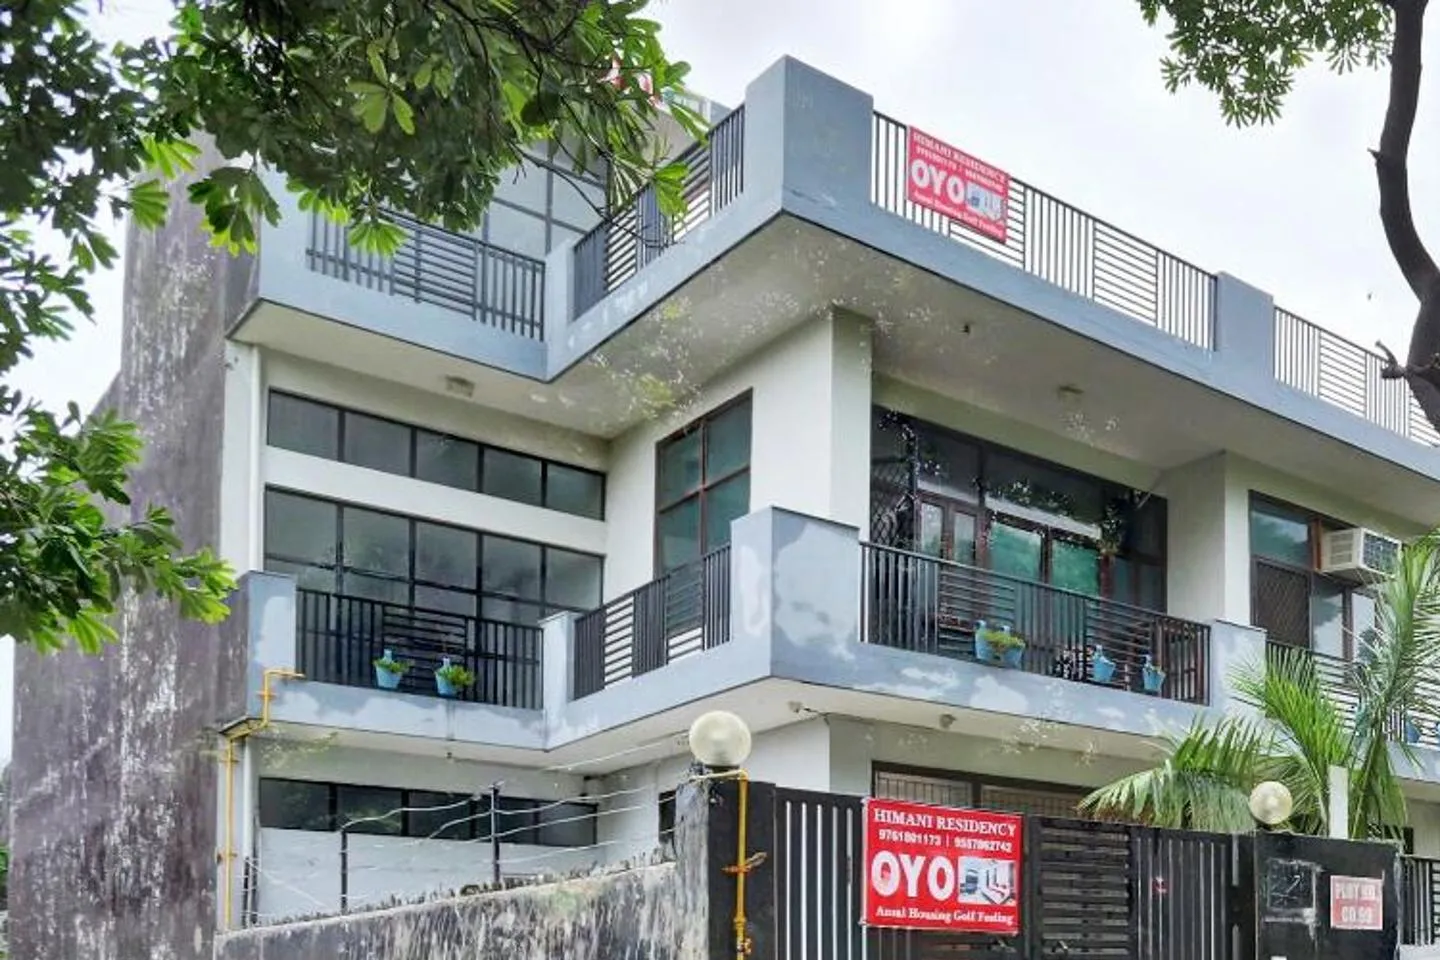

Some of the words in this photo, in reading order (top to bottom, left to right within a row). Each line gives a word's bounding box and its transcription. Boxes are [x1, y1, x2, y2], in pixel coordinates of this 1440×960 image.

[911, 158, 965, 204] OYO
[874, 808, 933, 829] HIMANI
[937, 816, 1016, 836] RESIDENCY
[871, 850, 956, 901] OYO
[908, 907, 952, 924] Housing
[953, 910, 977, 922] Golf
